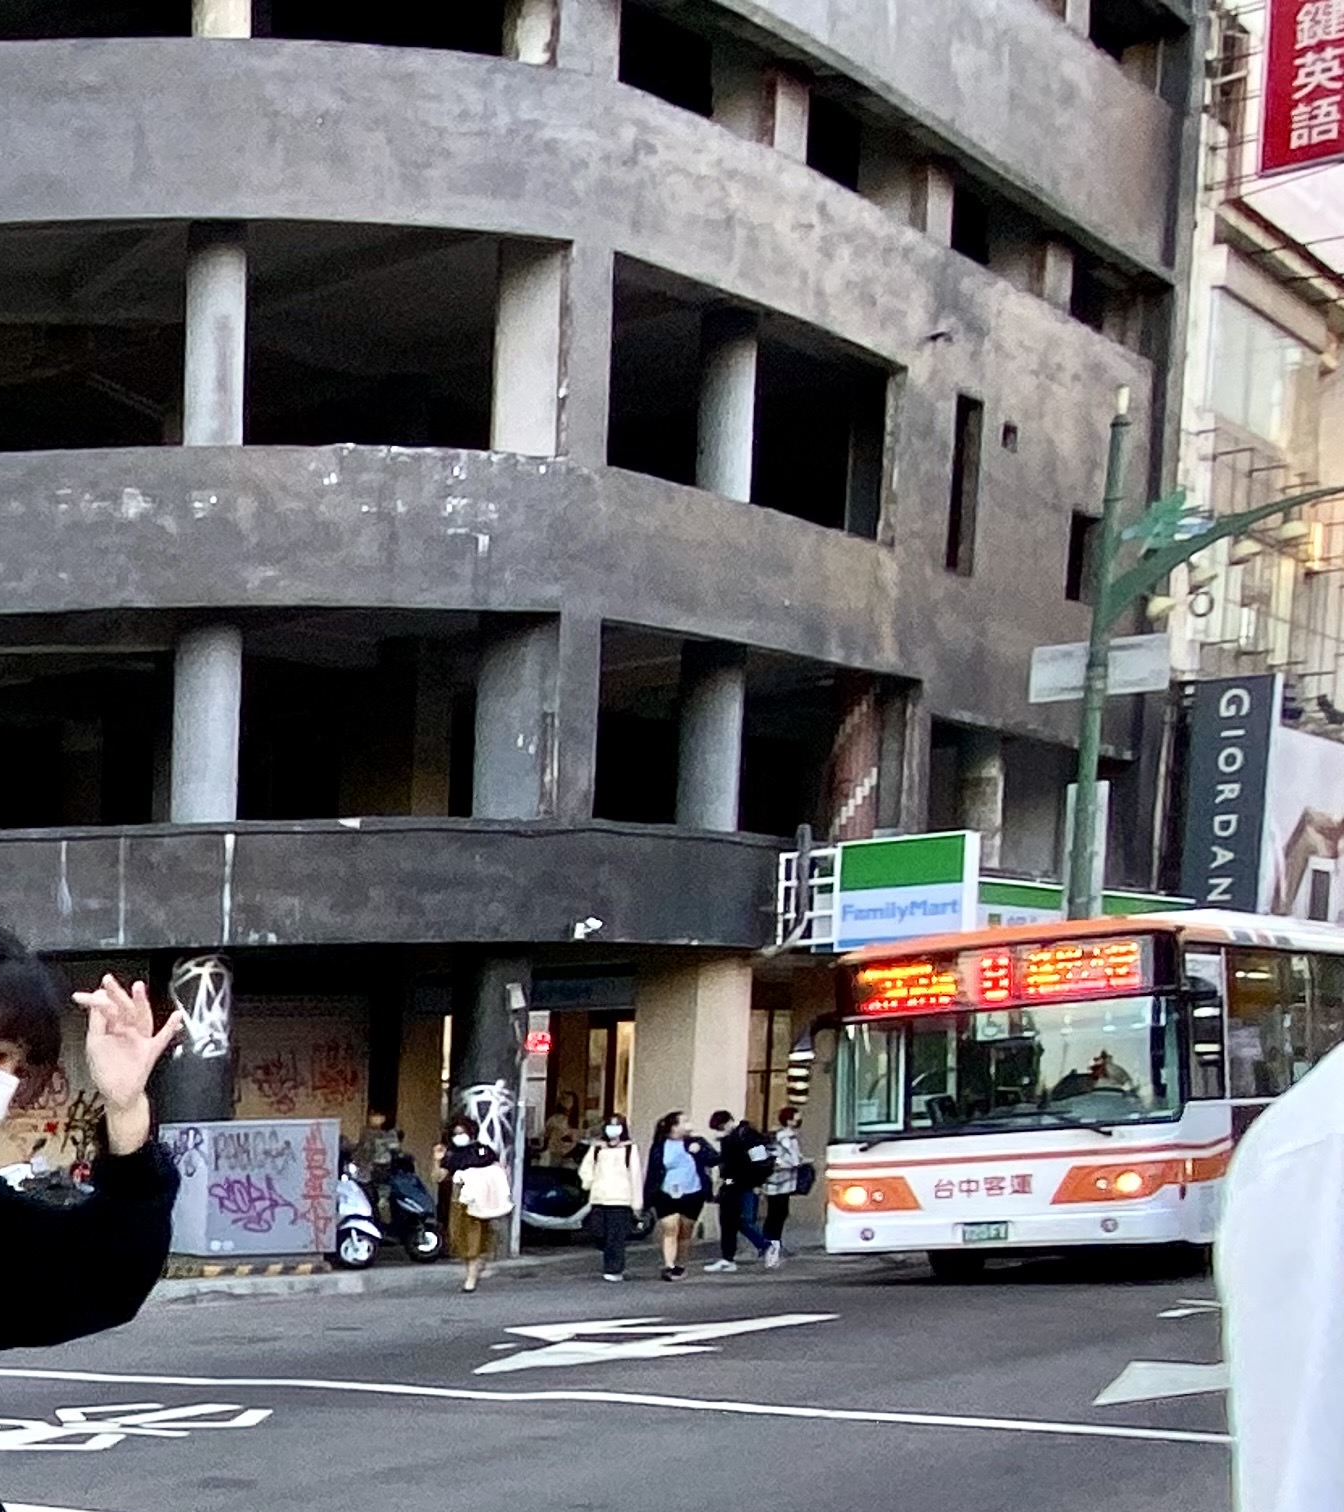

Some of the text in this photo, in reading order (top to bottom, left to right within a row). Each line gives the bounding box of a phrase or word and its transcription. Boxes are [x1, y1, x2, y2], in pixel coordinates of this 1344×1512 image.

[1207, 687, 1251, 901] GIORDAN
[842, 899, 958, 923] FamilyMart
[934, 1173, 1033, 1199] 台中客運
